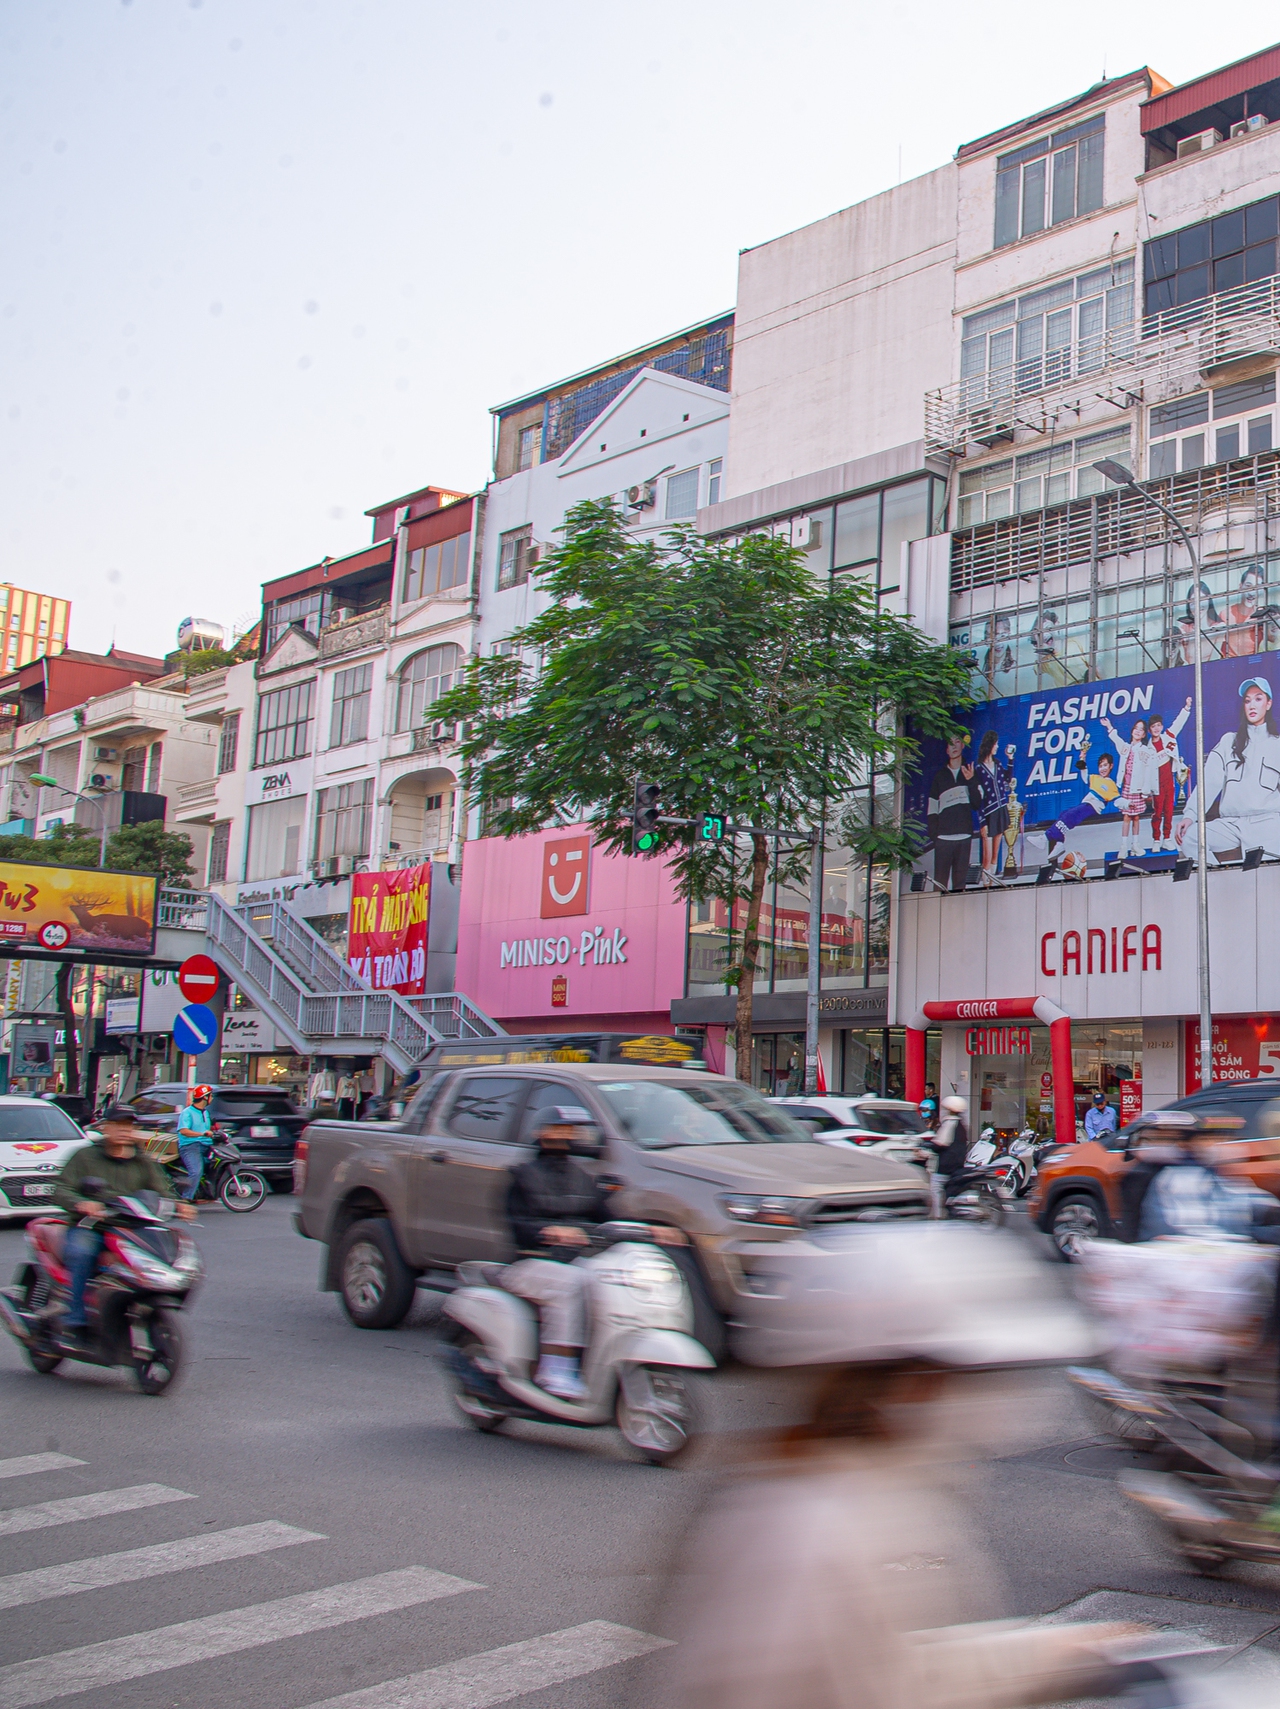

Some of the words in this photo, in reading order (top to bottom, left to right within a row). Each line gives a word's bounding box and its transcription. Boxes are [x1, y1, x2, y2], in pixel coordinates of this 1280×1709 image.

[1027, 685, 1154, 729] FASHION
[1028, 726, 1085, 757] FOR
[262, 772, 292, 790] ZENA
[1025, 756, 1078, 786] ALL
[262, 788, 292, 800] SHOES
[1024, 788, 1072, 798] www.canifa.com
[702, 817, 722, 839] 27
[353, 883, 379, 934] TRẢ
[500, 936, 570, 969] MINISO
[579, 925, 628, 966] Pink
[1041, 924, 1162, 977] CANIFA
[410, 940, 425, 988] BỘ
[956, 1001, 998, 1018] CANIFA
[55, 1030, 82, 1044] ZEA
[965, 1027, 1032, 1055] CANIFA
[1220, 1068, 1250, 1079] ĐÔNG
